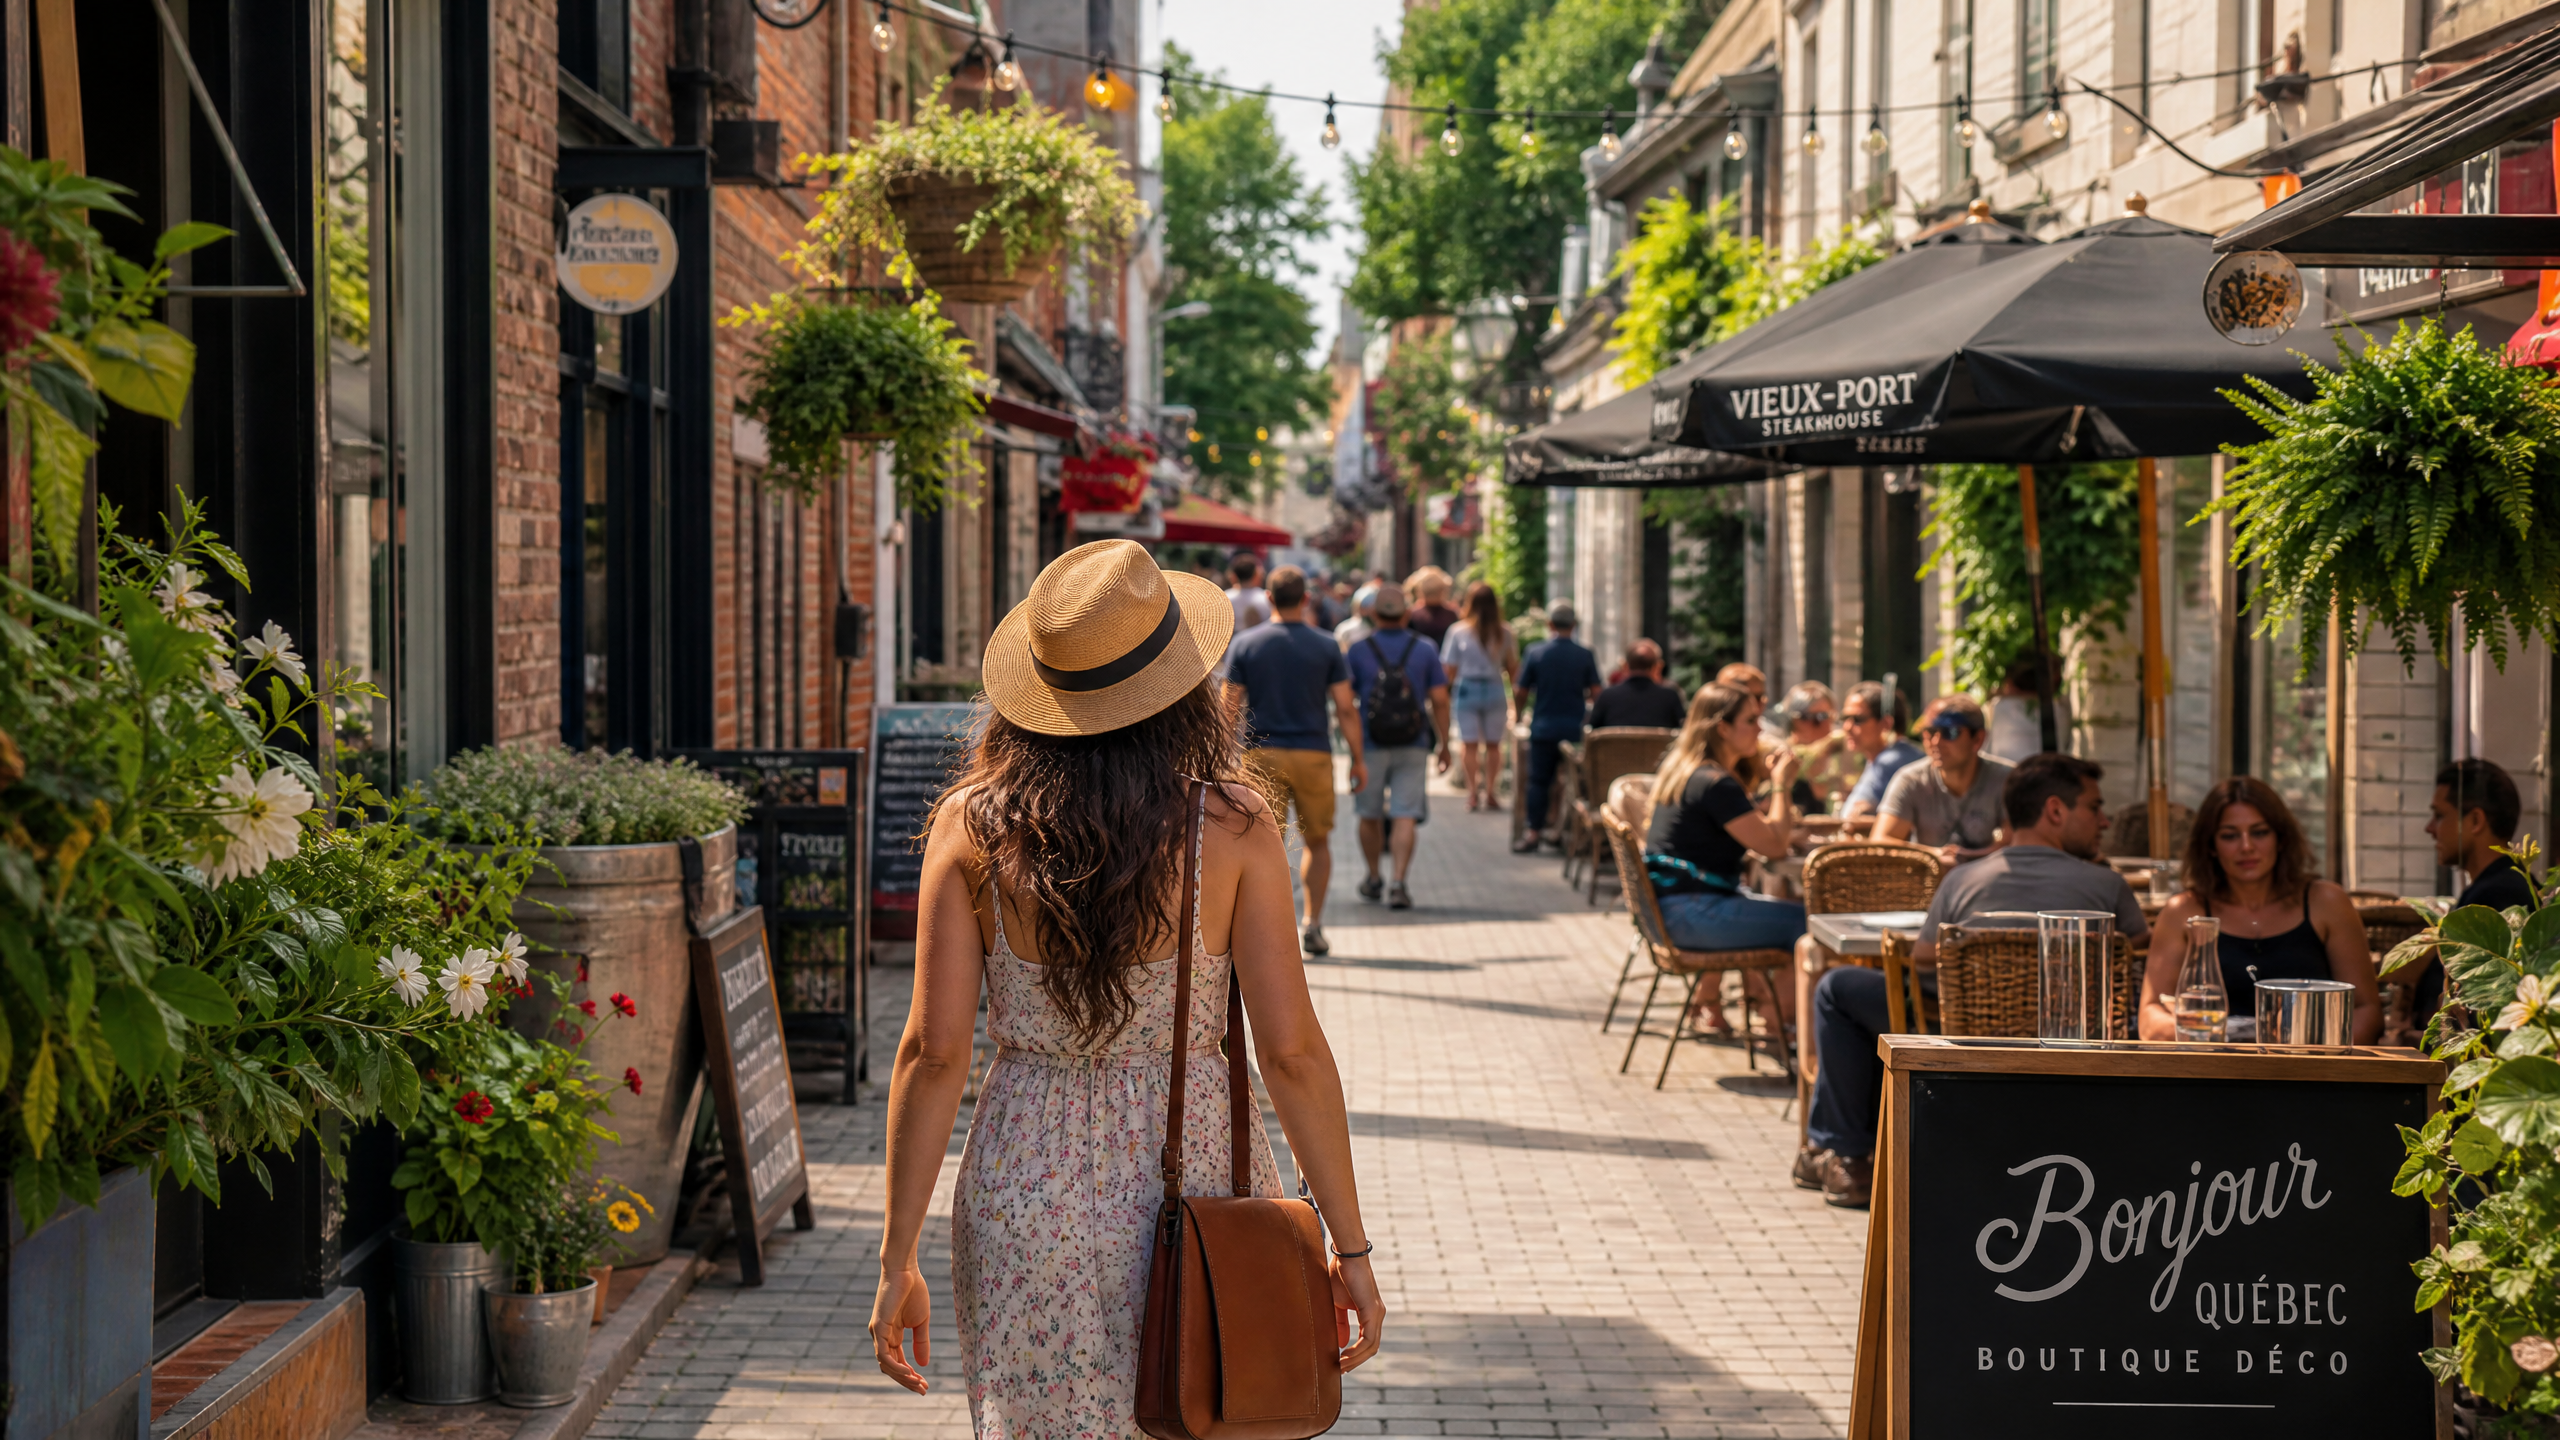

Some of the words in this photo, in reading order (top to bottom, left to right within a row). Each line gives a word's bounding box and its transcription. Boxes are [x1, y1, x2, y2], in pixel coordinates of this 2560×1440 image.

[1730, 371, 1918, 420] VIEUX-PORT
[1975, 1141, 2333, 1313] Bonjour
[2195, 1274, 2348, 1331] QUÉBEC
[1978, 1347, 2201, 1376] BOUTIQUE
[2236, 1344, 2349, 1375] DÉCO
